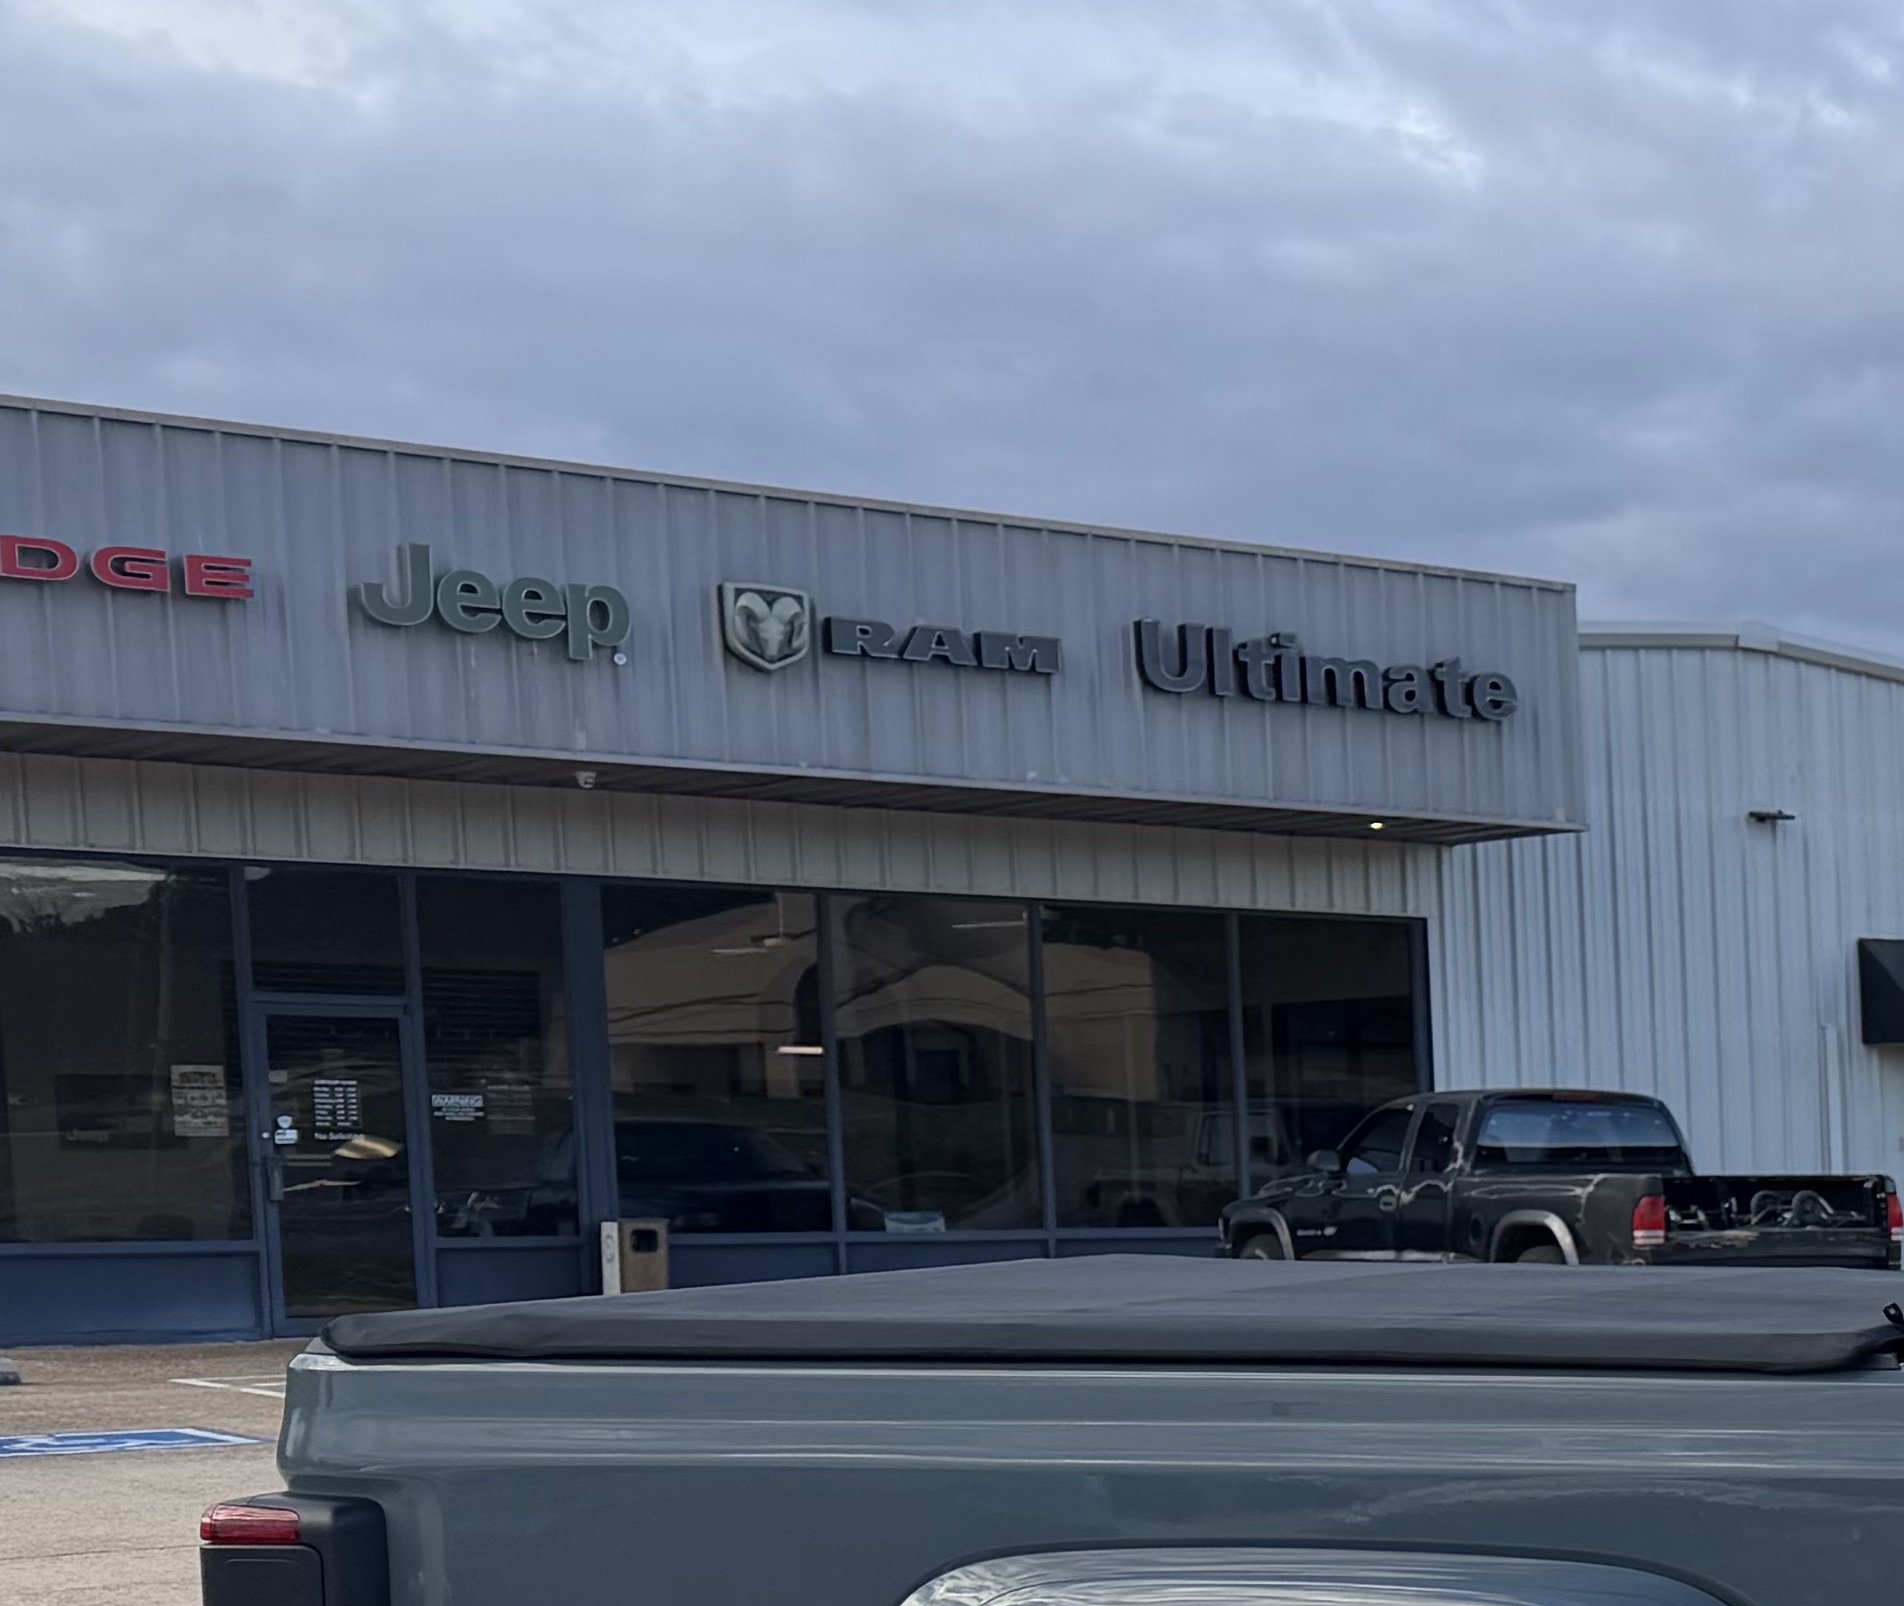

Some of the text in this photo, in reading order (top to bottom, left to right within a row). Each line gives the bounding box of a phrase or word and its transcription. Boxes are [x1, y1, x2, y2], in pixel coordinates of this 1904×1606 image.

[360, 543, 631, 661] Jeep
[822, 616, 1061, 675] RAM
[1134, 618, 1520, 722] Ultimate
